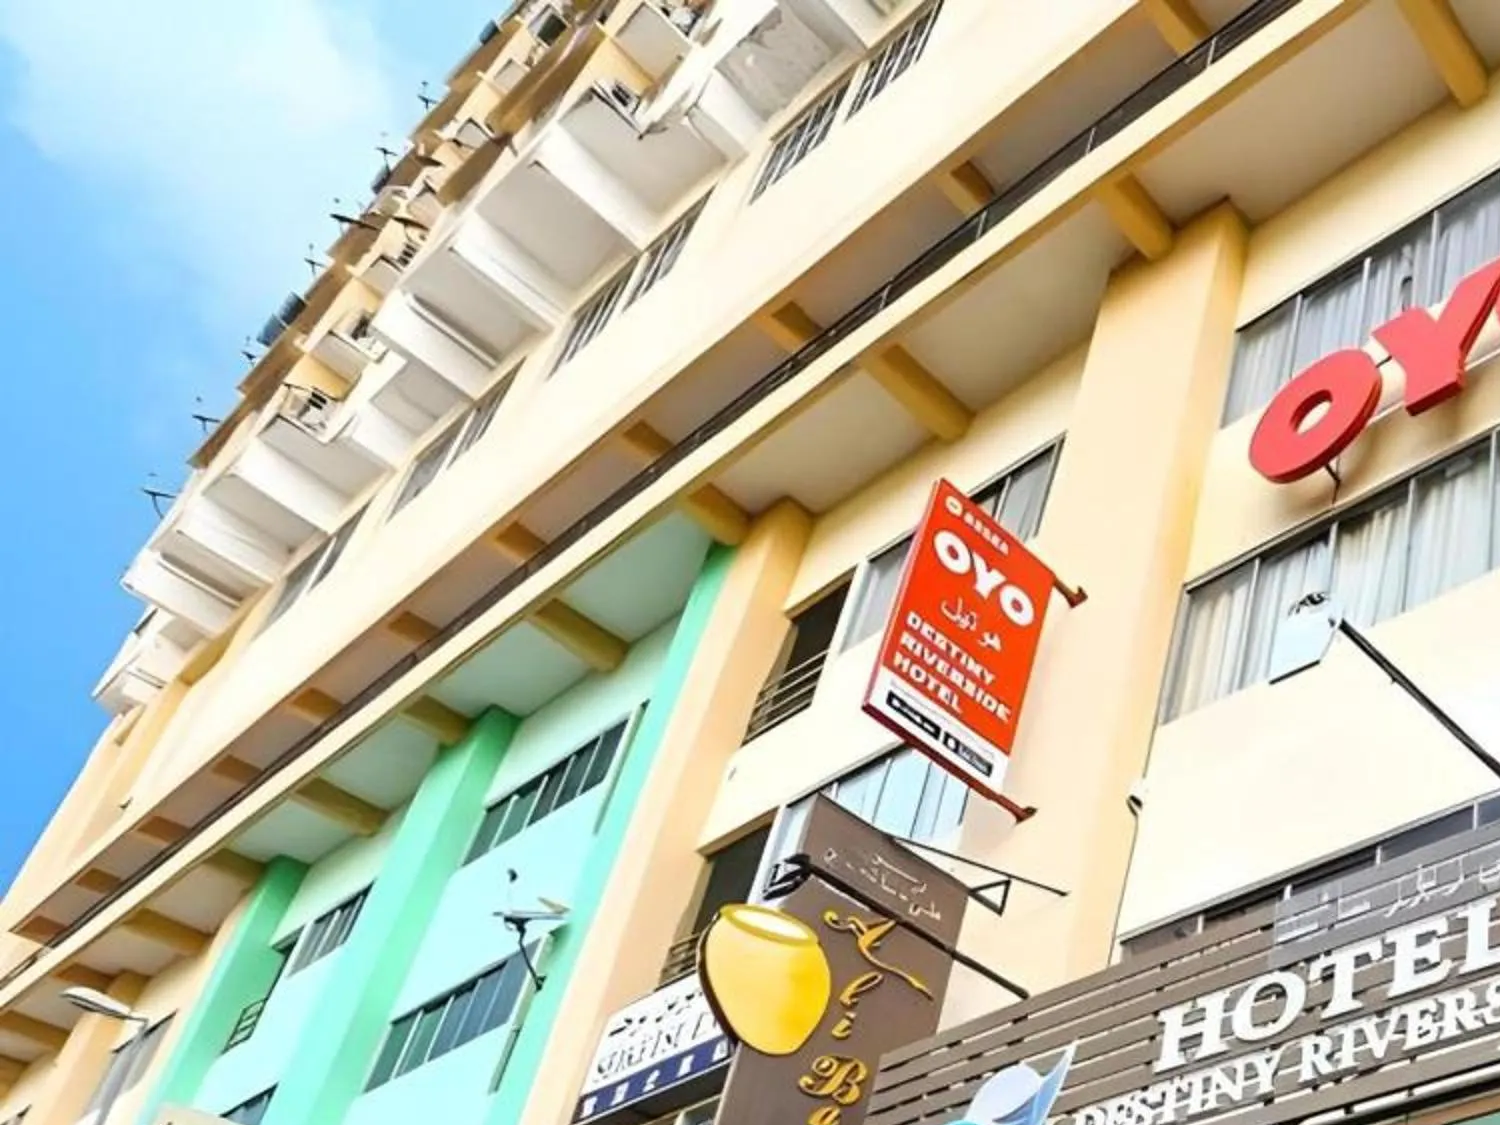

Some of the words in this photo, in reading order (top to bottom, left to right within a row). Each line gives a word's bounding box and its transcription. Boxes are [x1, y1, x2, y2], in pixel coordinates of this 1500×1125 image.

[932, 529, 1035, 627] OYO
[893, 651, 963, 714] HOTEL
[900, 632, 1012, 723] RIVERSIDE
[906, 611, 996, 685] DESTINY
